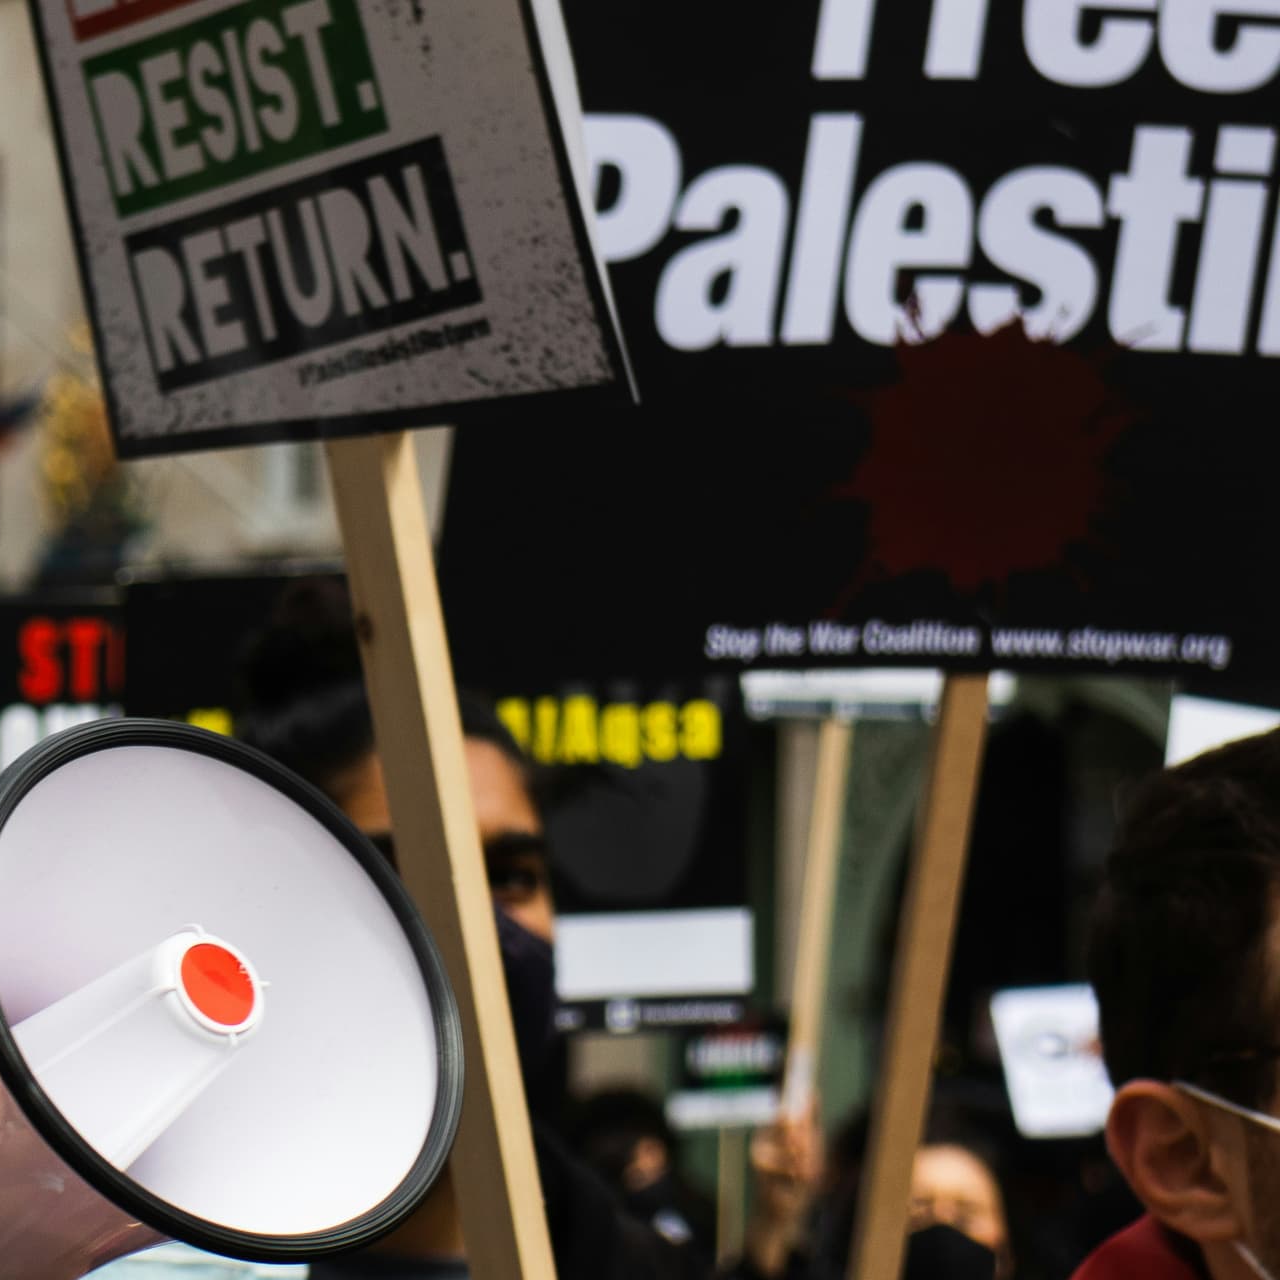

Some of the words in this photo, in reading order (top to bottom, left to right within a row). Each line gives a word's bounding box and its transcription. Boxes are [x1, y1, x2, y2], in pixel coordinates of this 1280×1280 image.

[91, 0, 379, 196] RESIST.
[133, 163, 471, 372] RETURN.
[703, 623, 760, 664] Stop
[763, 622, 804, 656] the
[807, 620, 860, 656] War
[862, 618, 982, 656] Coalition
[991, 625, 1231, 671] www.stopwar.org
